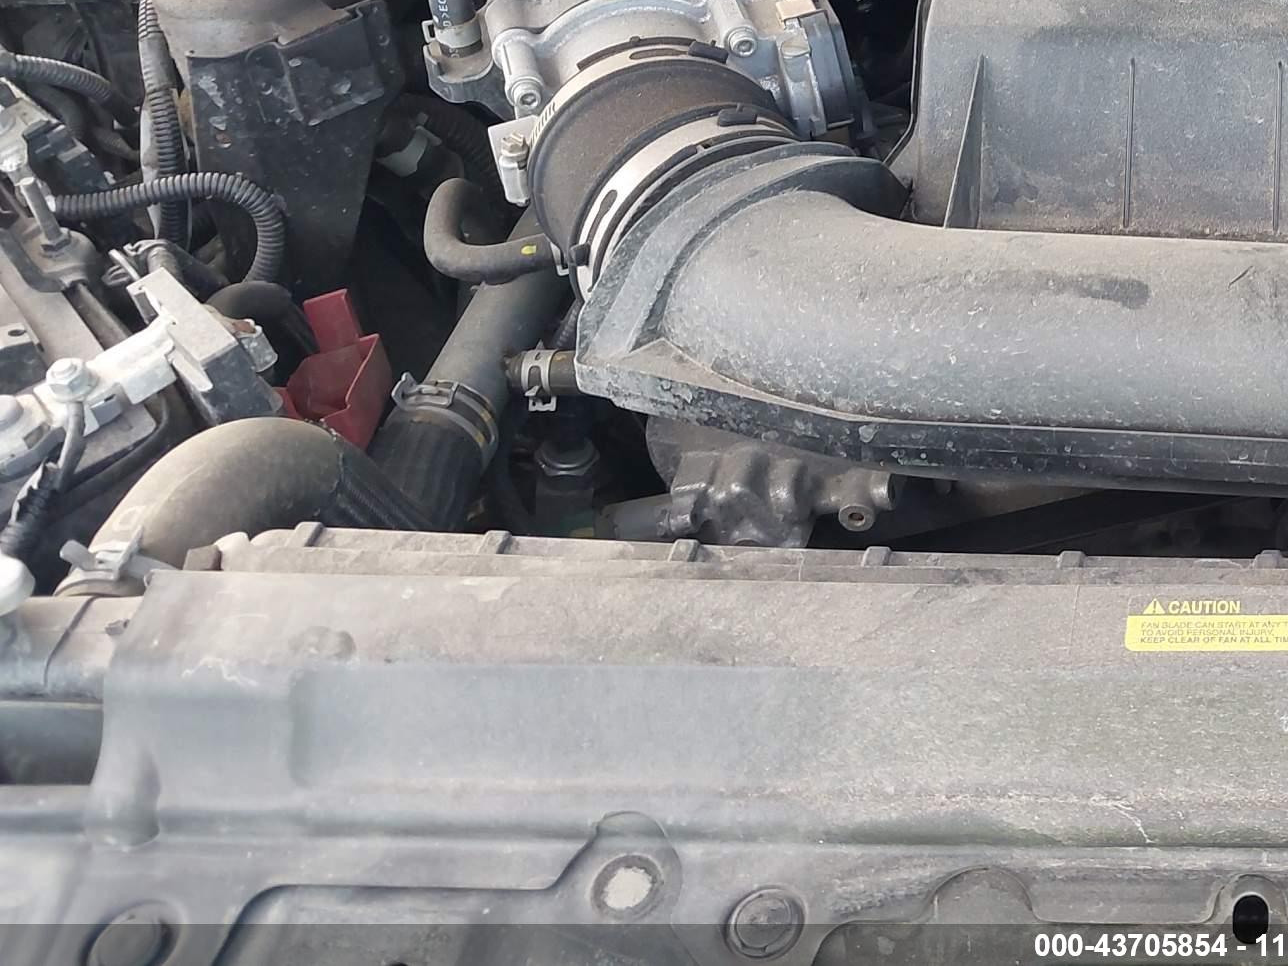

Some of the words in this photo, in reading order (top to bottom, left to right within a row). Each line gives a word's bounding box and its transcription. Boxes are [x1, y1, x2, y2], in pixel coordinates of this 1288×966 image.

[1167, 600, 1241, 614] CAUTION
[1161, 621, 1193, 629] BLADE
[1194, 621, 1215, 629] CAN
[1217, 621, 1248, 629] START
[1249, 621, 1262, 629] AT
[1262, 621, 1281, 629] ANY
